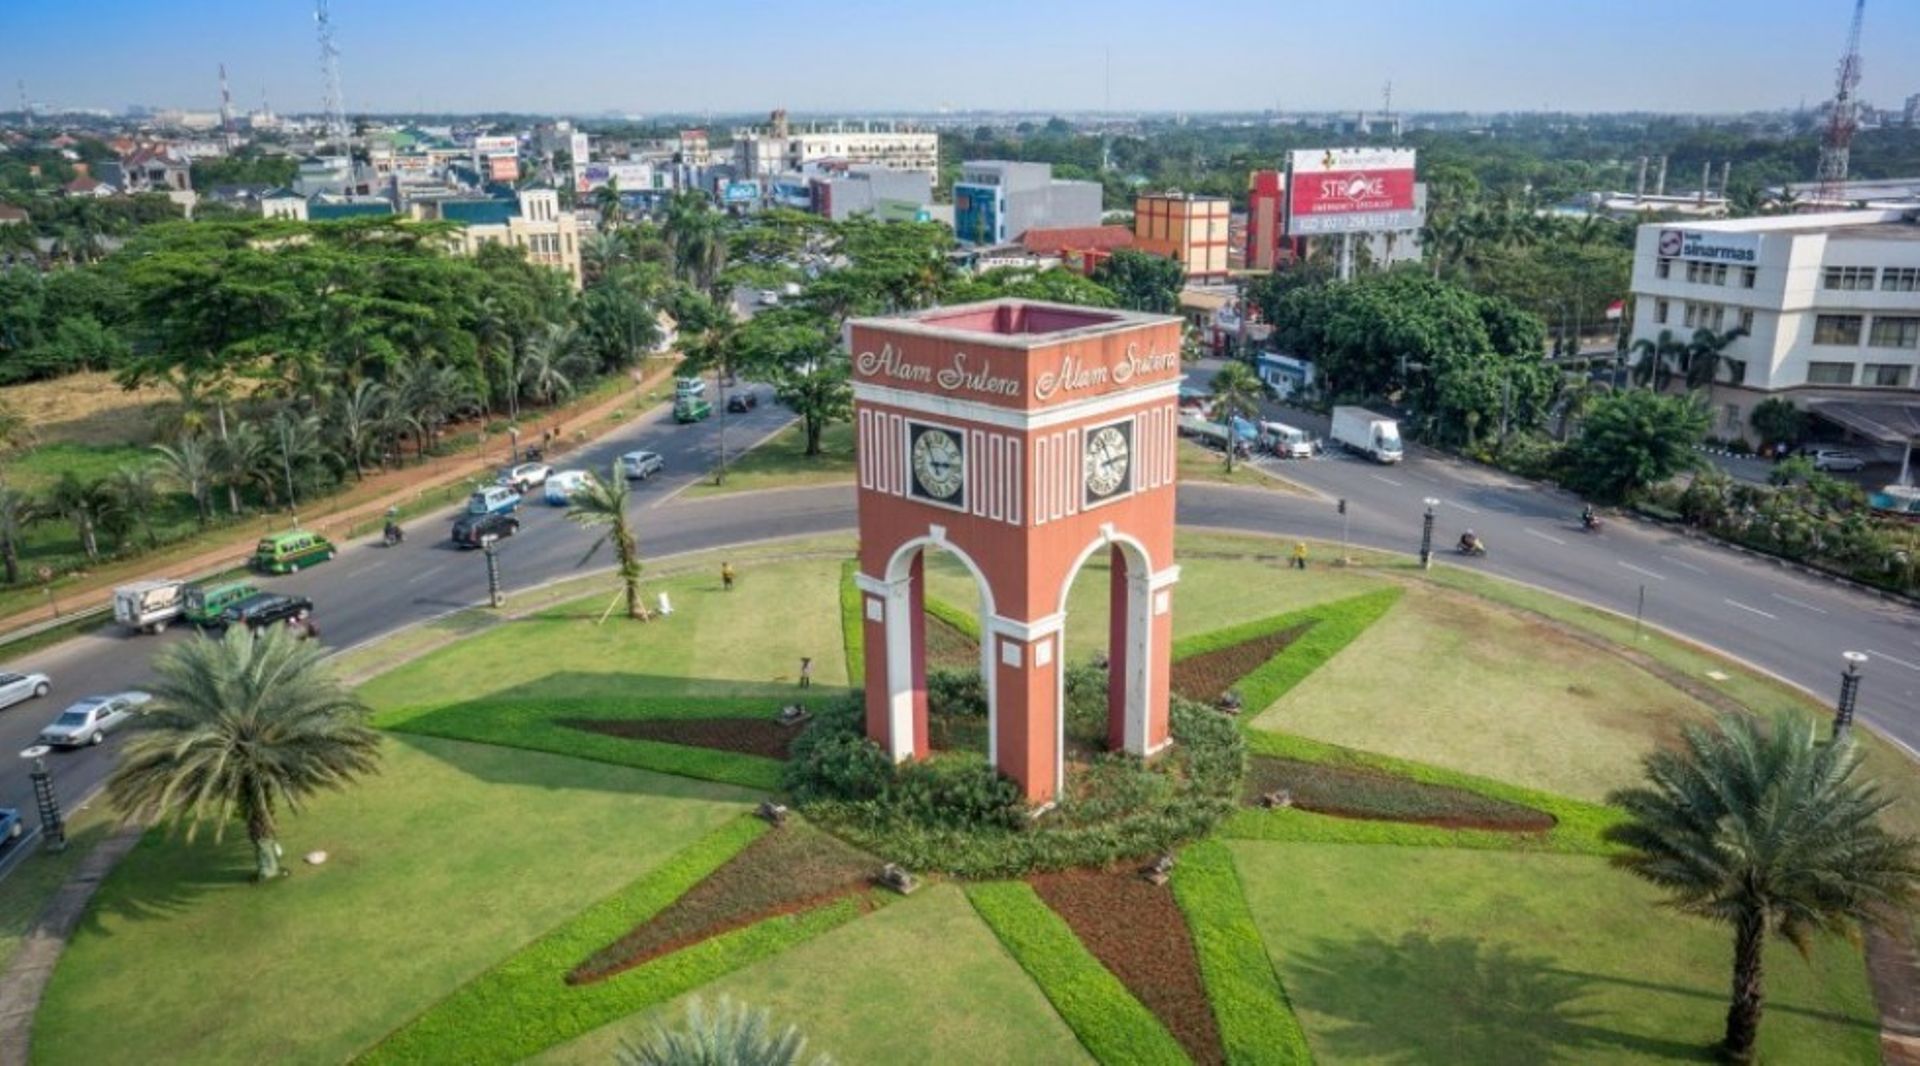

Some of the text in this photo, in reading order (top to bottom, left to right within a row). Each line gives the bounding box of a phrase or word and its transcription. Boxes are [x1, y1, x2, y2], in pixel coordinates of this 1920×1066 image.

[1684, 240, 1754, 261] sinarmas
[857, 344, 1020, 396] Alam Sutera
[1035, 342, 1176, 400] Alam Sutera
